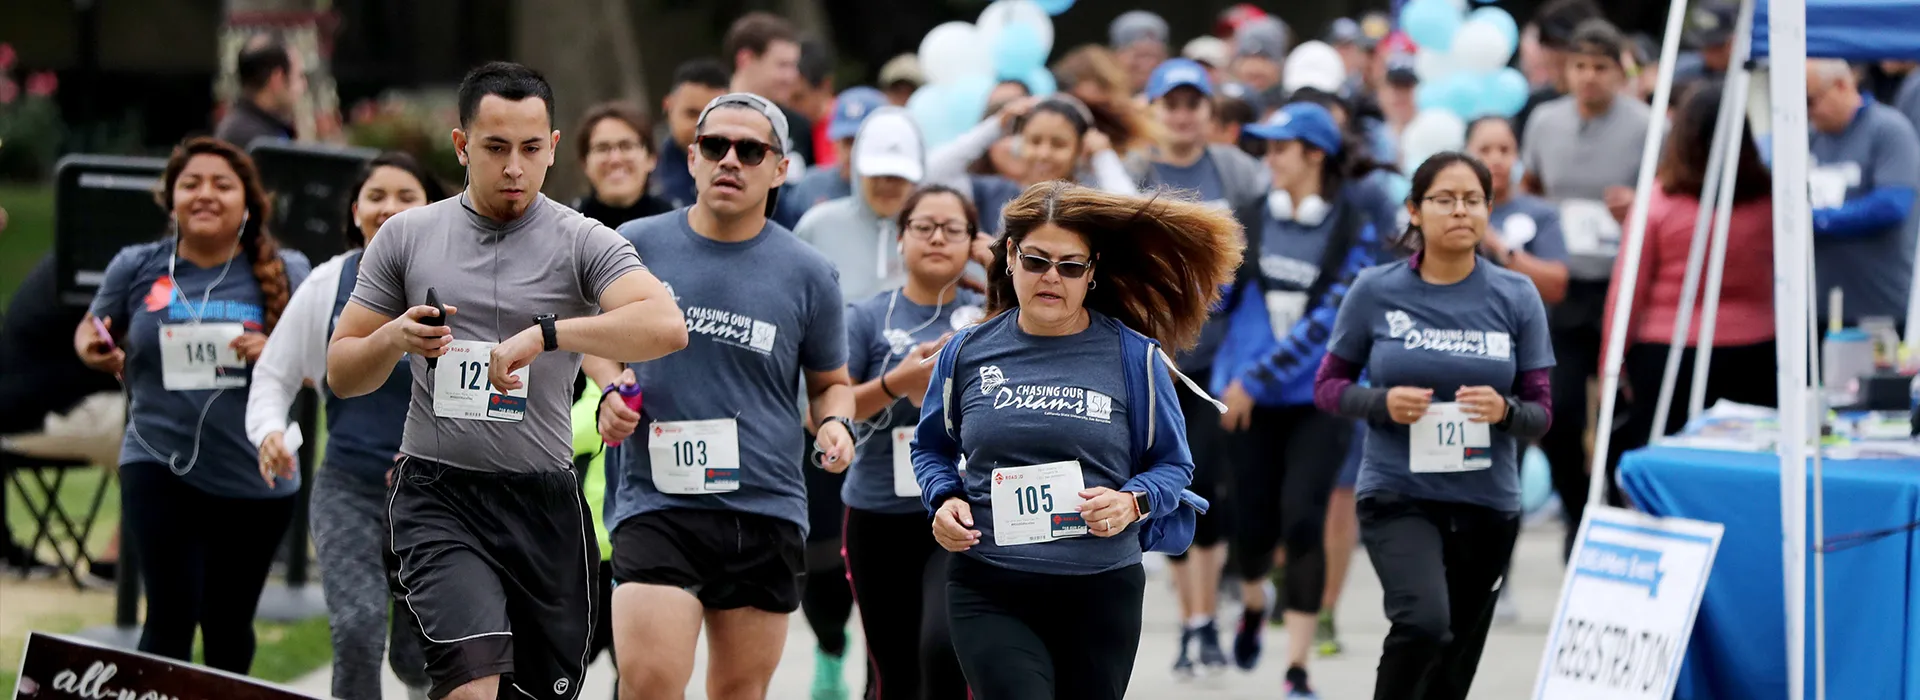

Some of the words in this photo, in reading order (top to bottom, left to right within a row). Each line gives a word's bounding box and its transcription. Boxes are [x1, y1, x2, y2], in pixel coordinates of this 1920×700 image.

[687, 306, 730, 324] CHASING
[730, 314, 752, 329] OUR
[686, 318, 750, 344] reams
[1404, 329, 1487, 355] Dreams
[1422, 328, 1463, 342] CHASING
[1464, 329, 1484, 342] OUR
[186, 342, 217, 364] 149
[993, 386, 1085, 415] Dreams
[1016, 385, 1060, 397] CHASING
[1062, 386, 1084, 399] OUR
[1437, 421, 1465, 446] 121
[672, 440, 707, 467] 103
[1015, 484, 1054, 515] 105
[1554, 617, 1677, 692] REGISTRATION
[53, 660, 179, 700] all-
